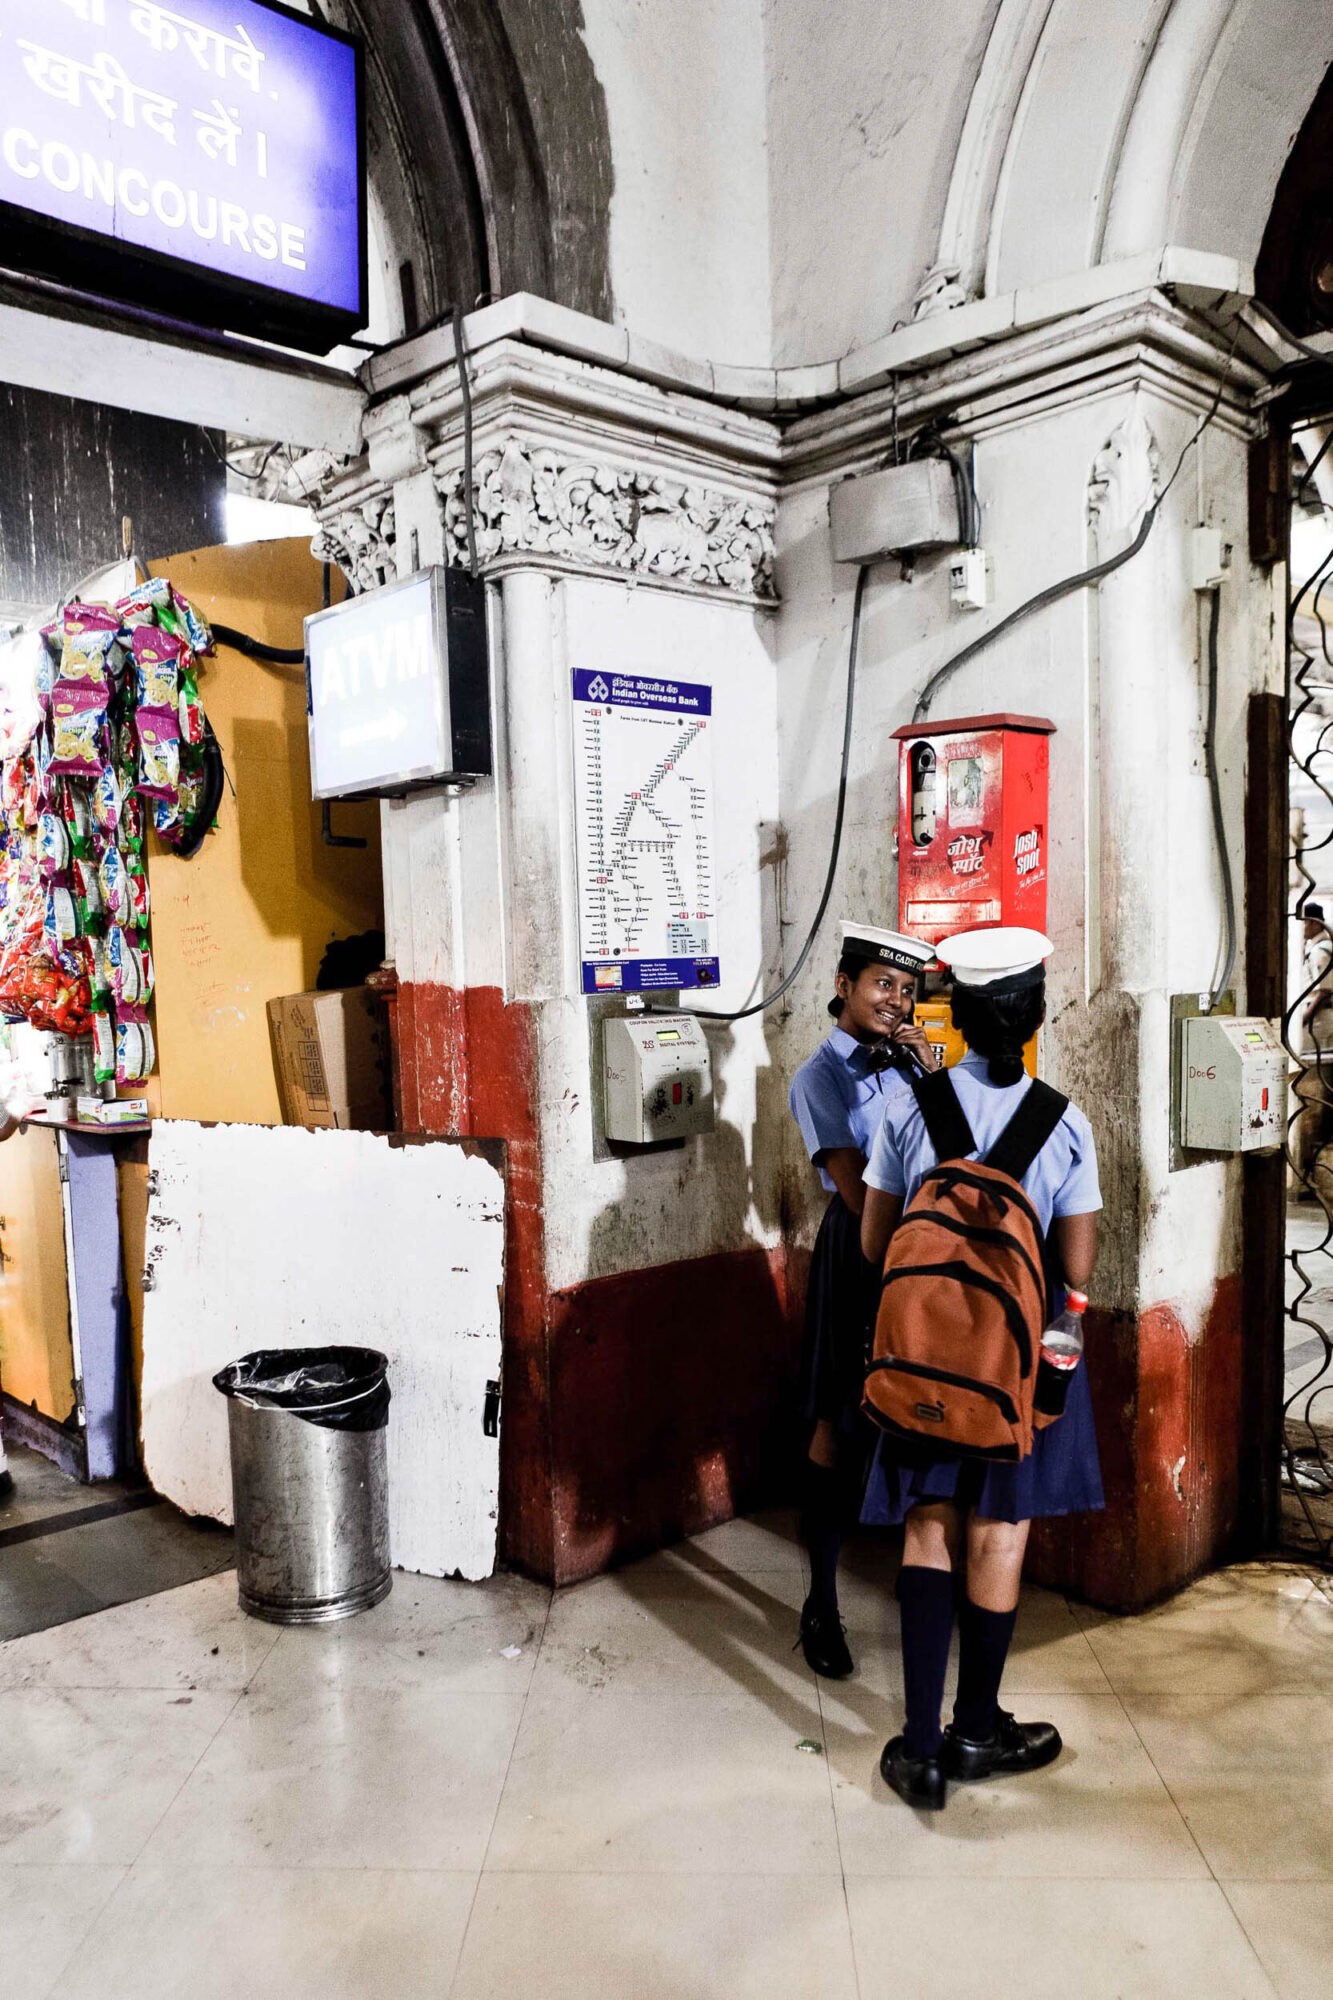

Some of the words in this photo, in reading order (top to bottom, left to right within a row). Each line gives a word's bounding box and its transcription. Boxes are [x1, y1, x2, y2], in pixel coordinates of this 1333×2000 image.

[2, 127, 307, 271] CONCOURSE
[319, 613, 430, 706] ATVM
[612, 687, 638, 699] Indian
[640, 691, 677, 704] Overseas
[678, 695, 699, 707] Bank
[947, 835, 983, 857] जोश
[952, 852, 986, 876] स्पॉट
[1016, 848, 1041, 875] spot
[879, 948, 894, 960] SEA
[895, 953, 918, 968] CADET
